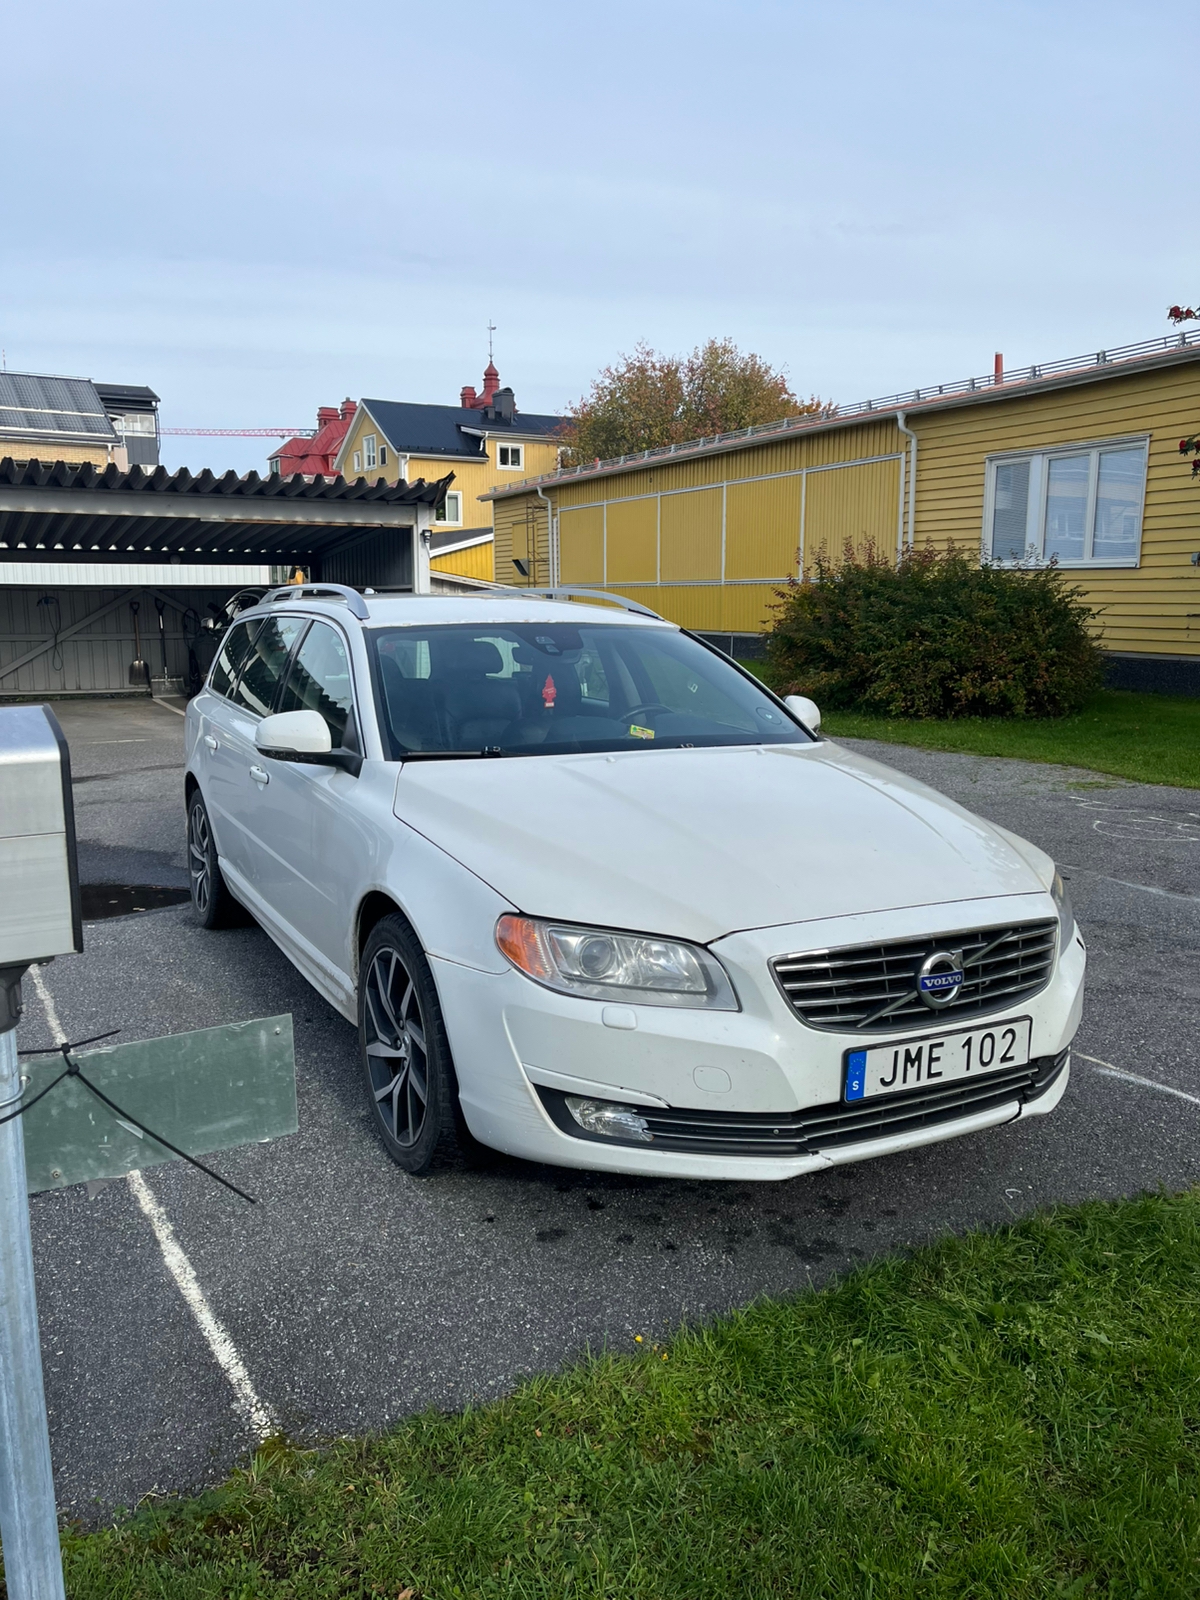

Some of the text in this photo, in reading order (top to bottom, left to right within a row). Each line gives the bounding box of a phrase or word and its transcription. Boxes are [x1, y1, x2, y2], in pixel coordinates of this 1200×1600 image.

[923, 974, 962, 987] VOLVO
[879, 1028, 1016, 1087] JME 102
[852, 1080, 860, 1091] S
